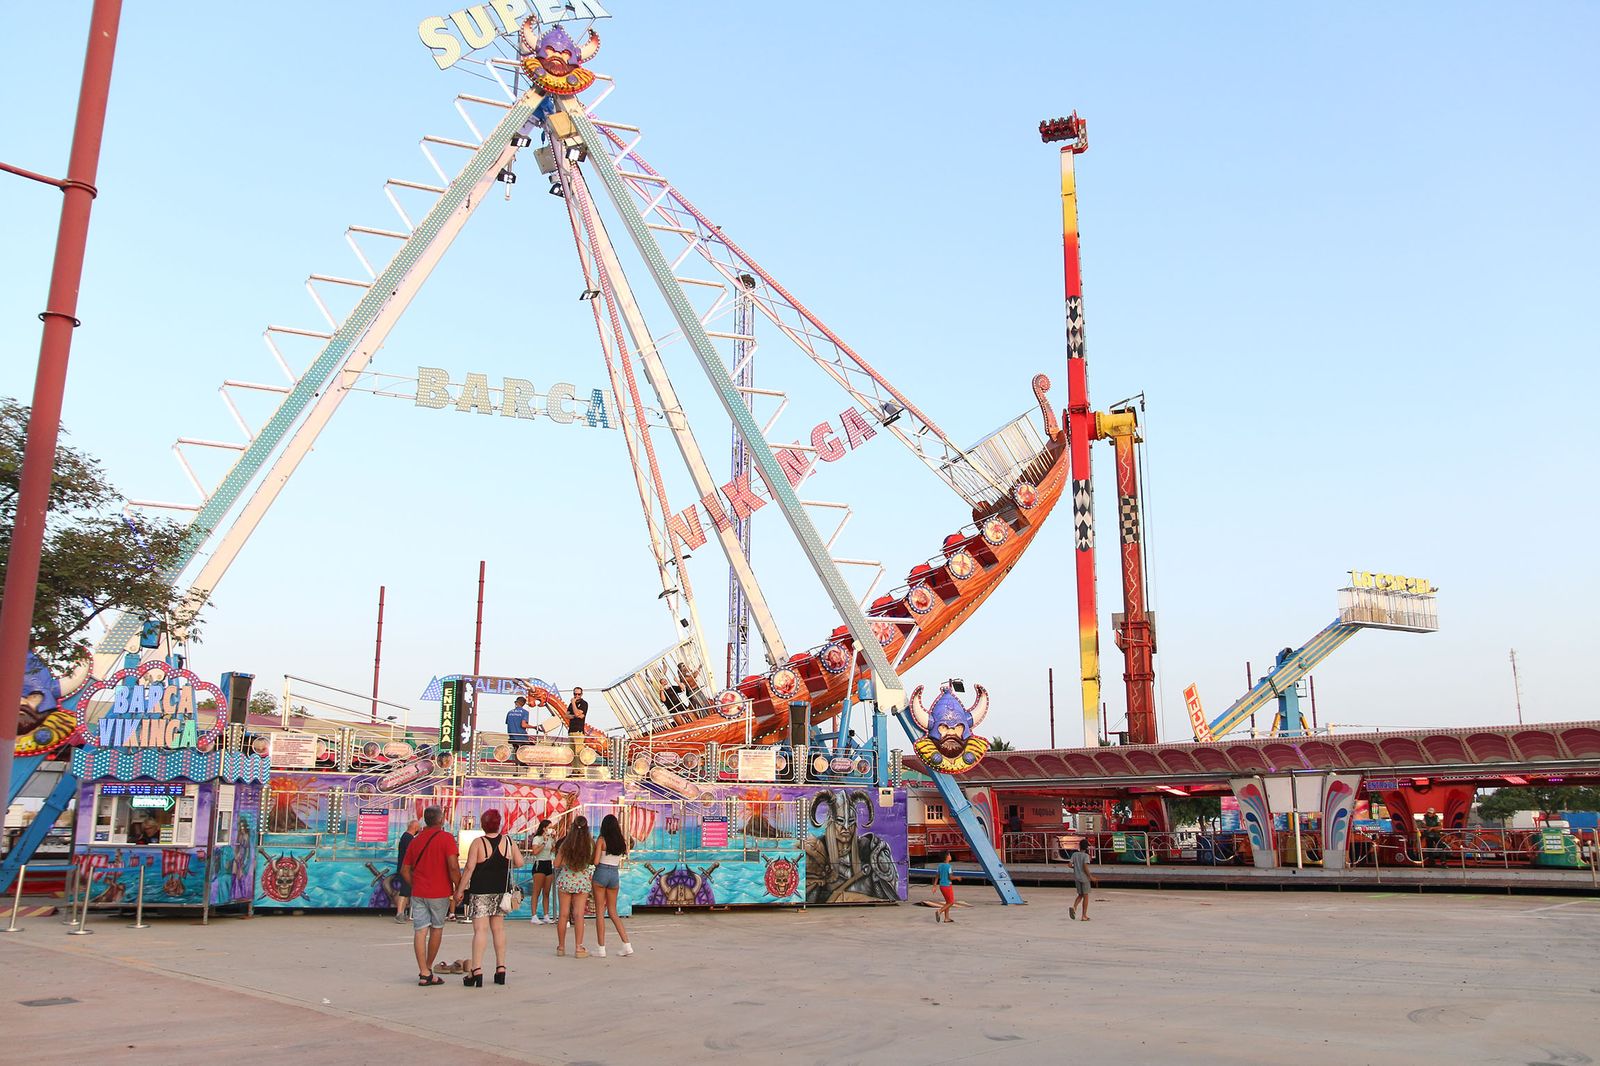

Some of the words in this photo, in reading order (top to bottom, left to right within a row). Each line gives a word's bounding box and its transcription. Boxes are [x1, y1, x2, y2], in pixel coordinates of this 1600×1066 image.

[415, 366, 618, 430] BARCA
[668, 406, 878, 552] VIKNGA
[1352, 569, 1372, 588] LA
[113, 685, 193, 714] BARCA
[464, 677, 527, 695] ALIDA
[441, 687, 453, 743] ENTRADA
[98, 718, 197, 748] VIKINGA
